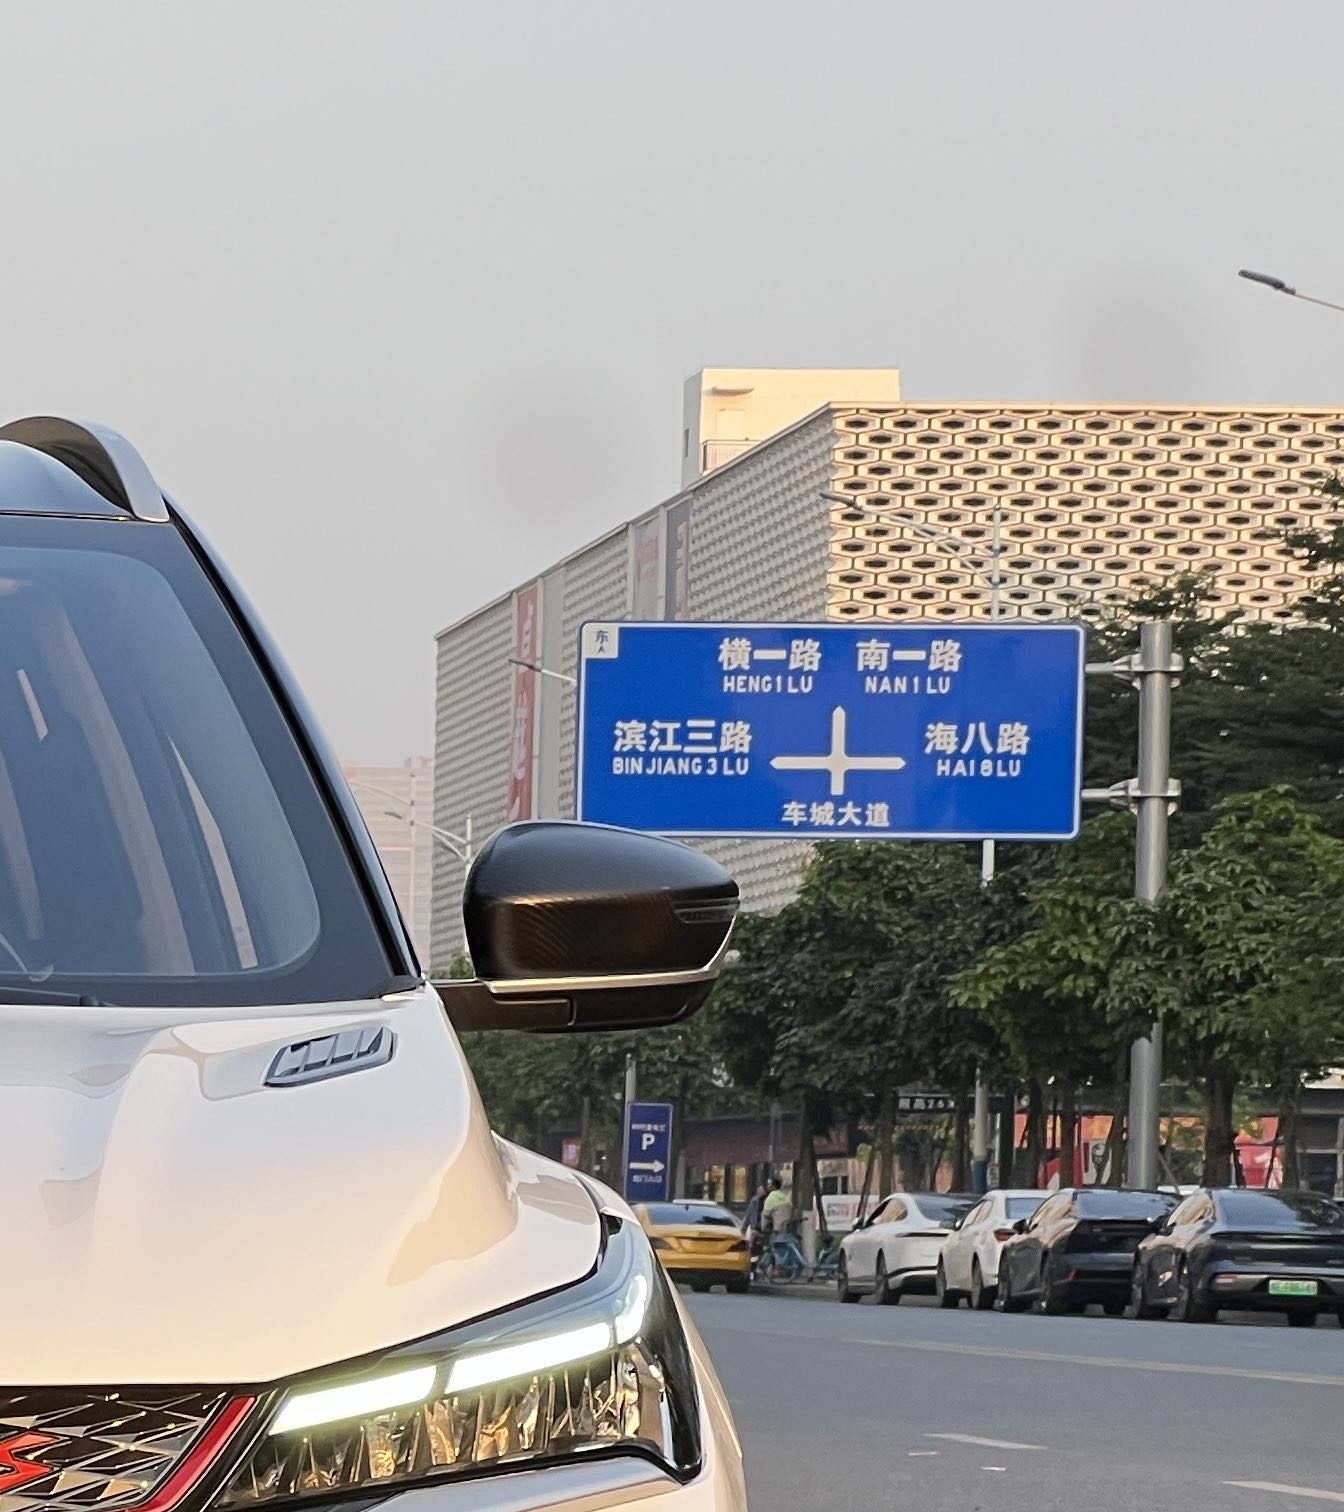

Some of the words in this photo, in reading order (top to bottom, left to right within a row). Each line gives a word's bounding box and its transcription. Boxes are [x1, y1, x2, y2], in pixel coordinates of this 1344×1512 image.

[718, 637, 822, 672] 横一路
[855, 638, 962, 672] 南一路
[612, 718, 753, 754] 滨江三路
[923, 721, 1031, 756] 海八路
[780, 800, 891, 828] 车城大道
[641, 1132, 656, 1151] P
